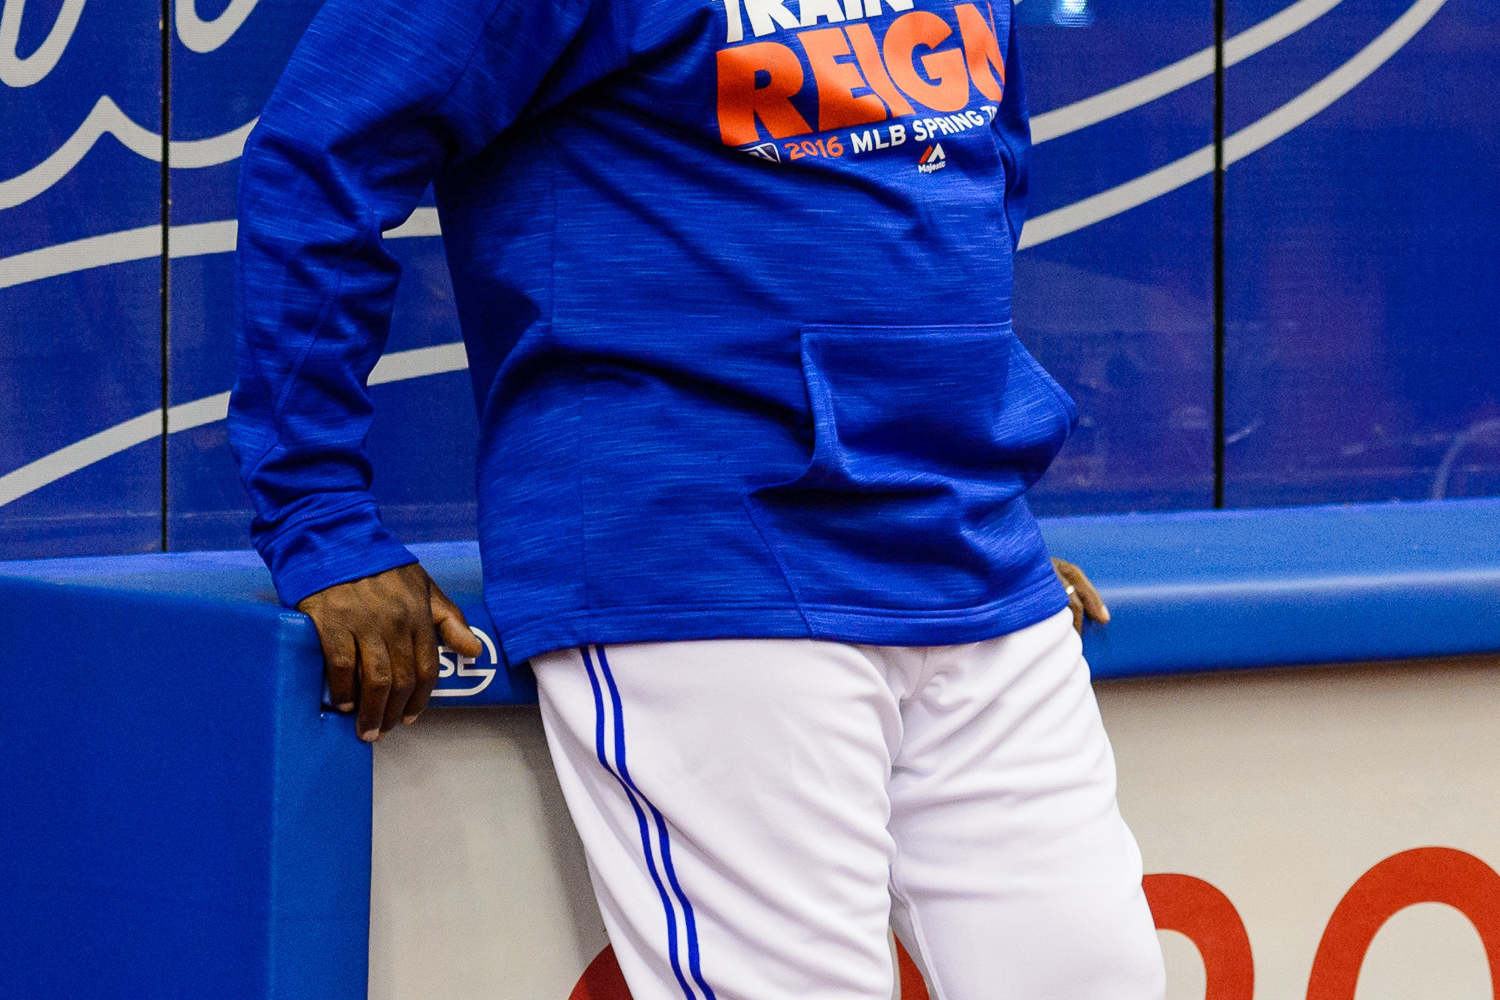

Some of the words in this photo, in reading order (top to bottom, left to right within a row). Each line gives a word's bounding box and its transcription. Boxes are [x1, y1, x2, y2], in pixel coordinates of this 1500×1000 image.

[716, 2, 1006, 146] REIGN
[784, 136, 844, 160] 2016
[850, 124, 906, 154] MLB
[914, 110, 985, 141] SPRING
[917, 160, 946, 175] Majestic
